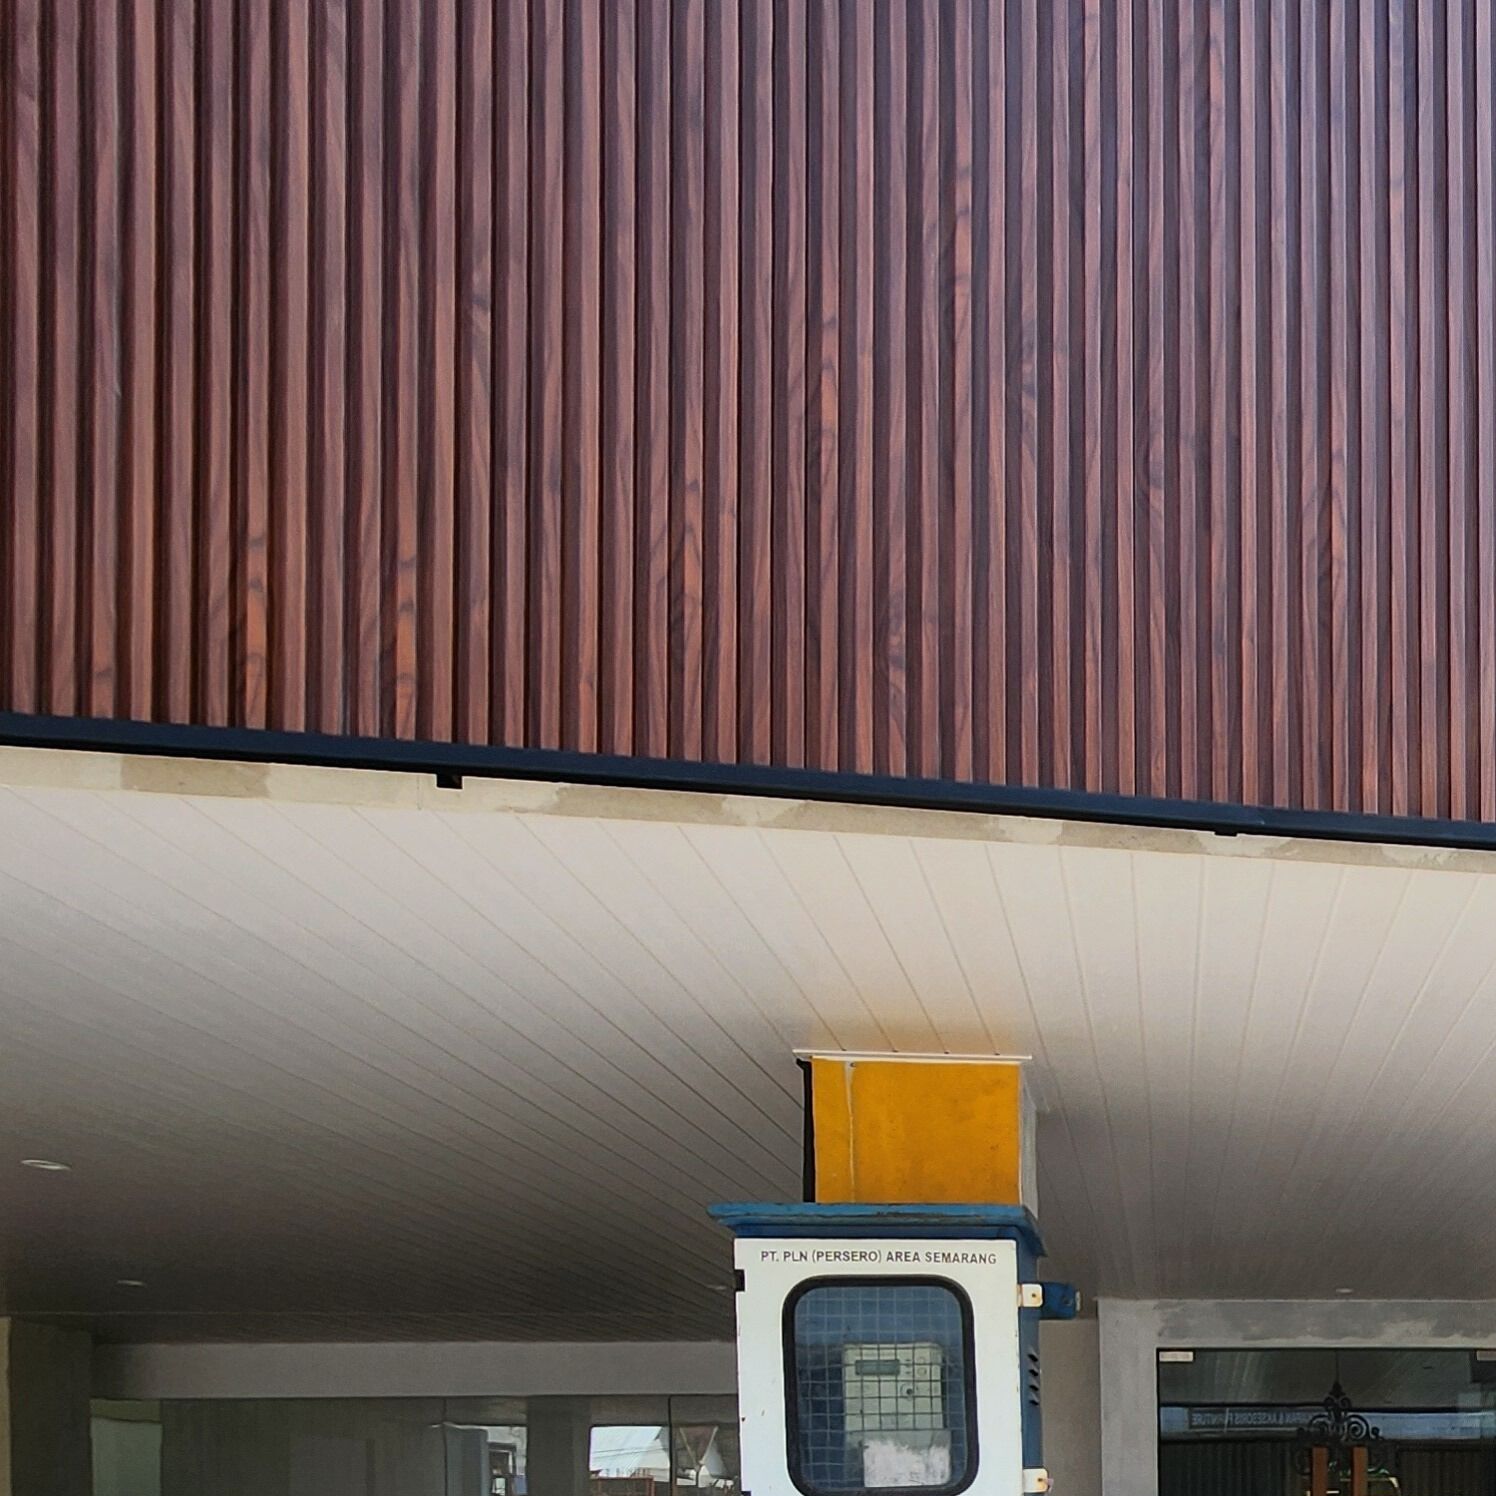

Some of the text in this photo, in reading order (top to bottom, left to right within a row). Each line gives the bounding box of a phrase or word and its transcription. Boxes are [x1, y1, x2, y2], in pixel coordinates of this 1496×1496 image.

[761, 1250, 997, 1265] PT. PLN (PERSERO) AREA SEMARANG
